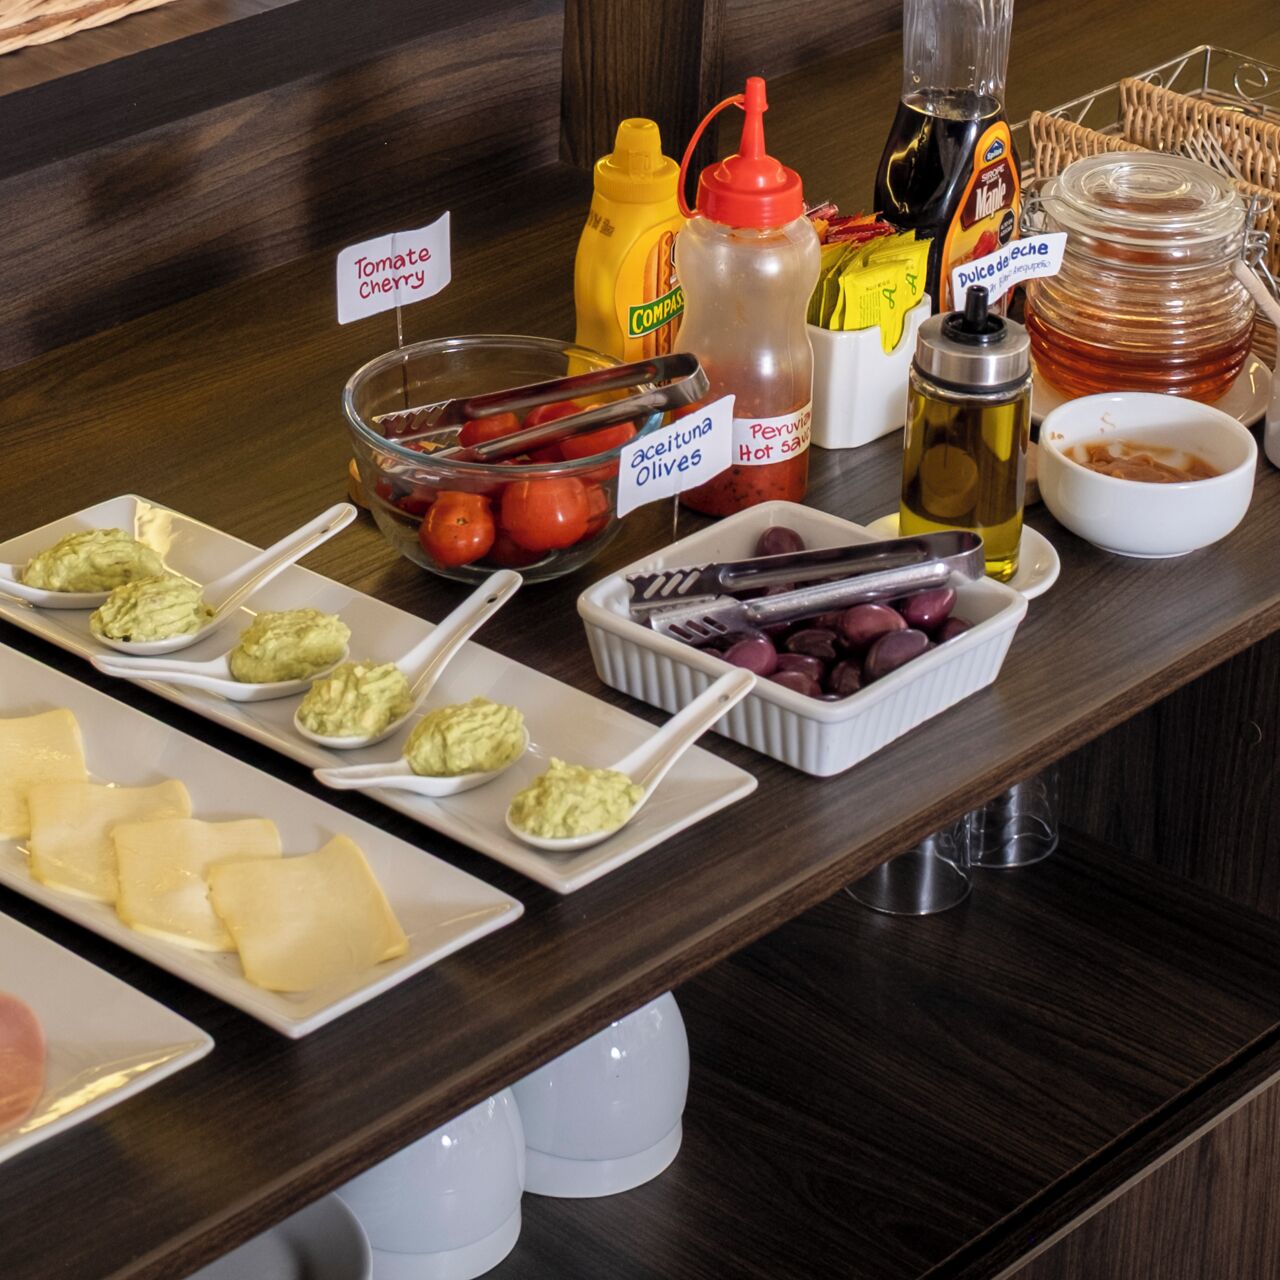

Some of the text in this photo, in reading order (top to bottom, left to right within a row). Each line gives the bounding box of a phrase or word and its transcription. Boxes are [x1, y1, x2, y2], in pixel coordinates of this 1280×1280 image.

[975, 179, 1007, 221] Maple
[354, 248, 432, 280] Tomate
[958, 263, 995, 288] Dulce
[996, 256, 1010, 272] de
[632, 289, 685, 335] COMPAS
[631, 417, 713, 469] aceituna
[739, 444, 774, 462] Hot
[636, 449, 703, 487] Olives
